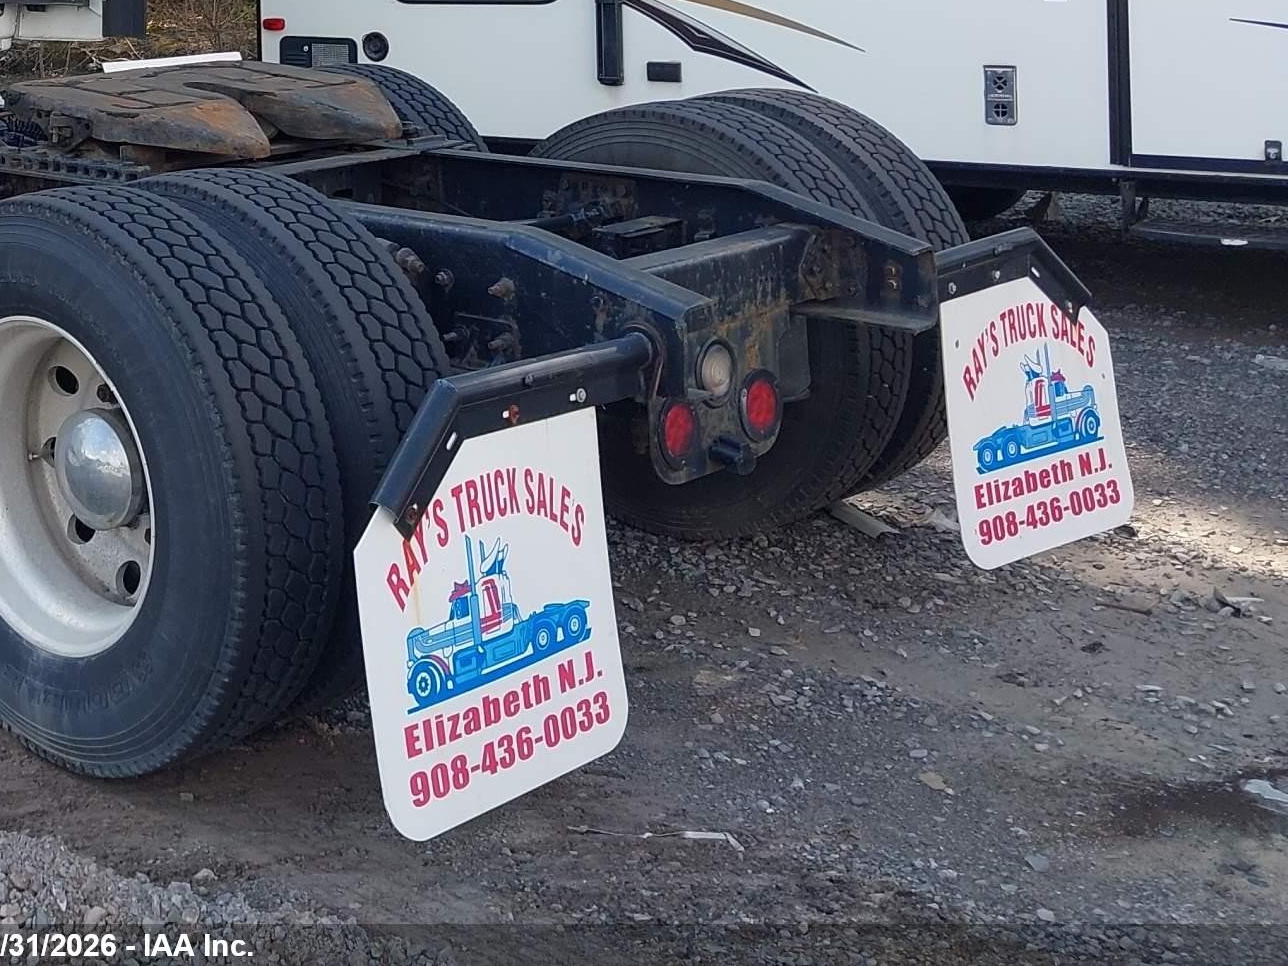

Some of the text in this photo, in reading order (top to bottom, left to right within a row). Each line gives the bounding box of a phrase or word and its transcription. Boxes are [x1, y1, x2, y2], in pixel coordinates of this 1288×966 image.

[963, 302, 1096, 402] RAY'S TRUCK SALES
[974, 447, 1113, 510] Elizabeth N.J.
[978, 479, 1121, 546] 908-436-0033
[386, 498, 450, 613] RAY'S
[450, 467, 521, 533] TRUCK
[403, 651, 603, 759] Elizabeth N.J.
[409, 691, 611, 808] 908-436-0033
